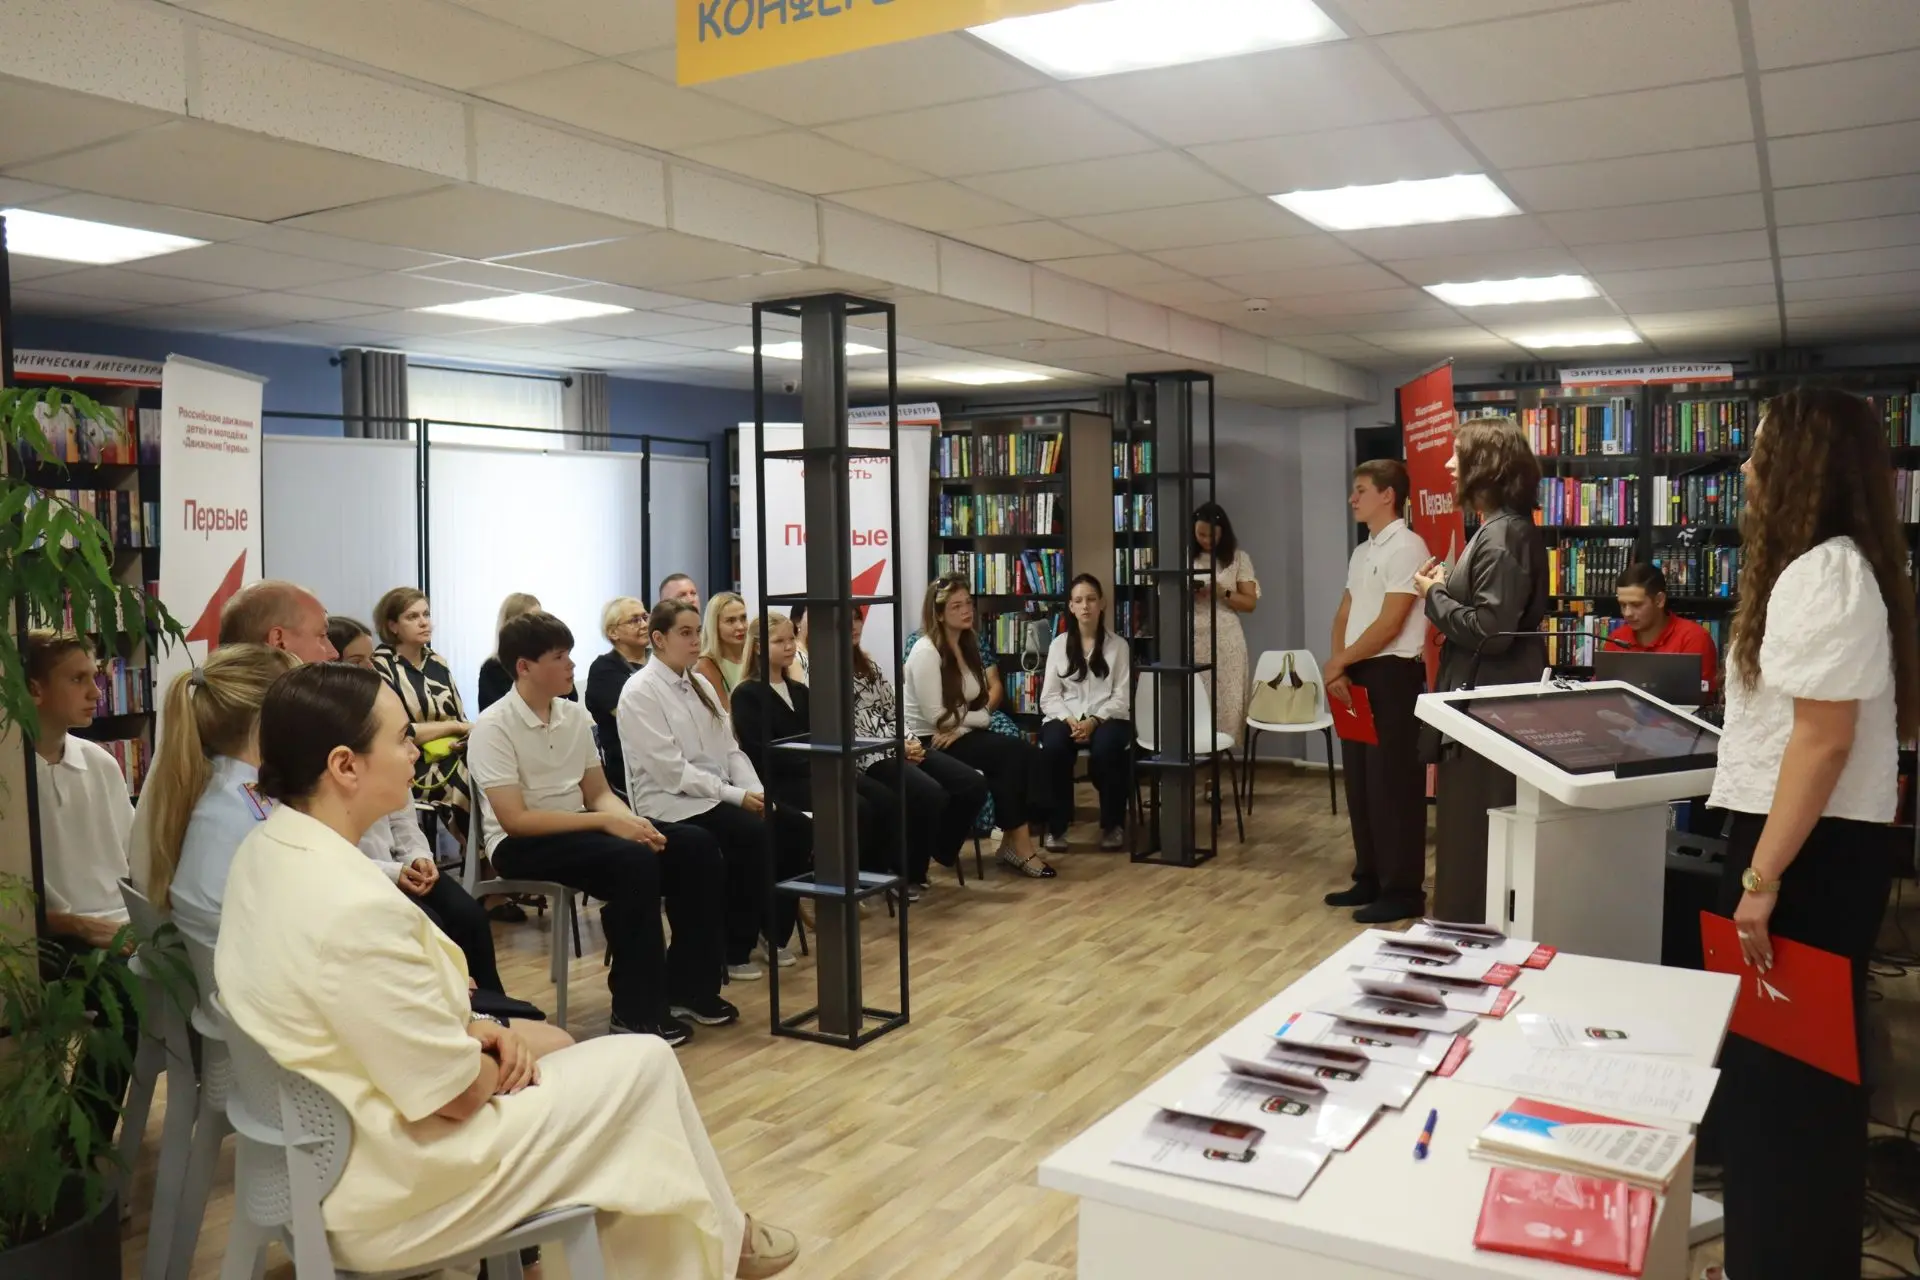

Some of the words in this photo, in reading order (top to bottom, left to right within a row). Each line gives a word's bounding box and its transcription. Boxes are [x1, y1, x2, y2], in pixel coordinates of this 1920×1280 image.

[698, 0, 896, 42] КОНФ
[1570, 367, 1645, 377] ЗАРУБЕЖНАЯ
[1649, 364, 1722, 374] ЛИТЕРАТУРА
[897, 406, 937, 417] ТЕРАТУРА
[184, 499, 248, 540] Первые
[785, 524, 888, 546] Пые
